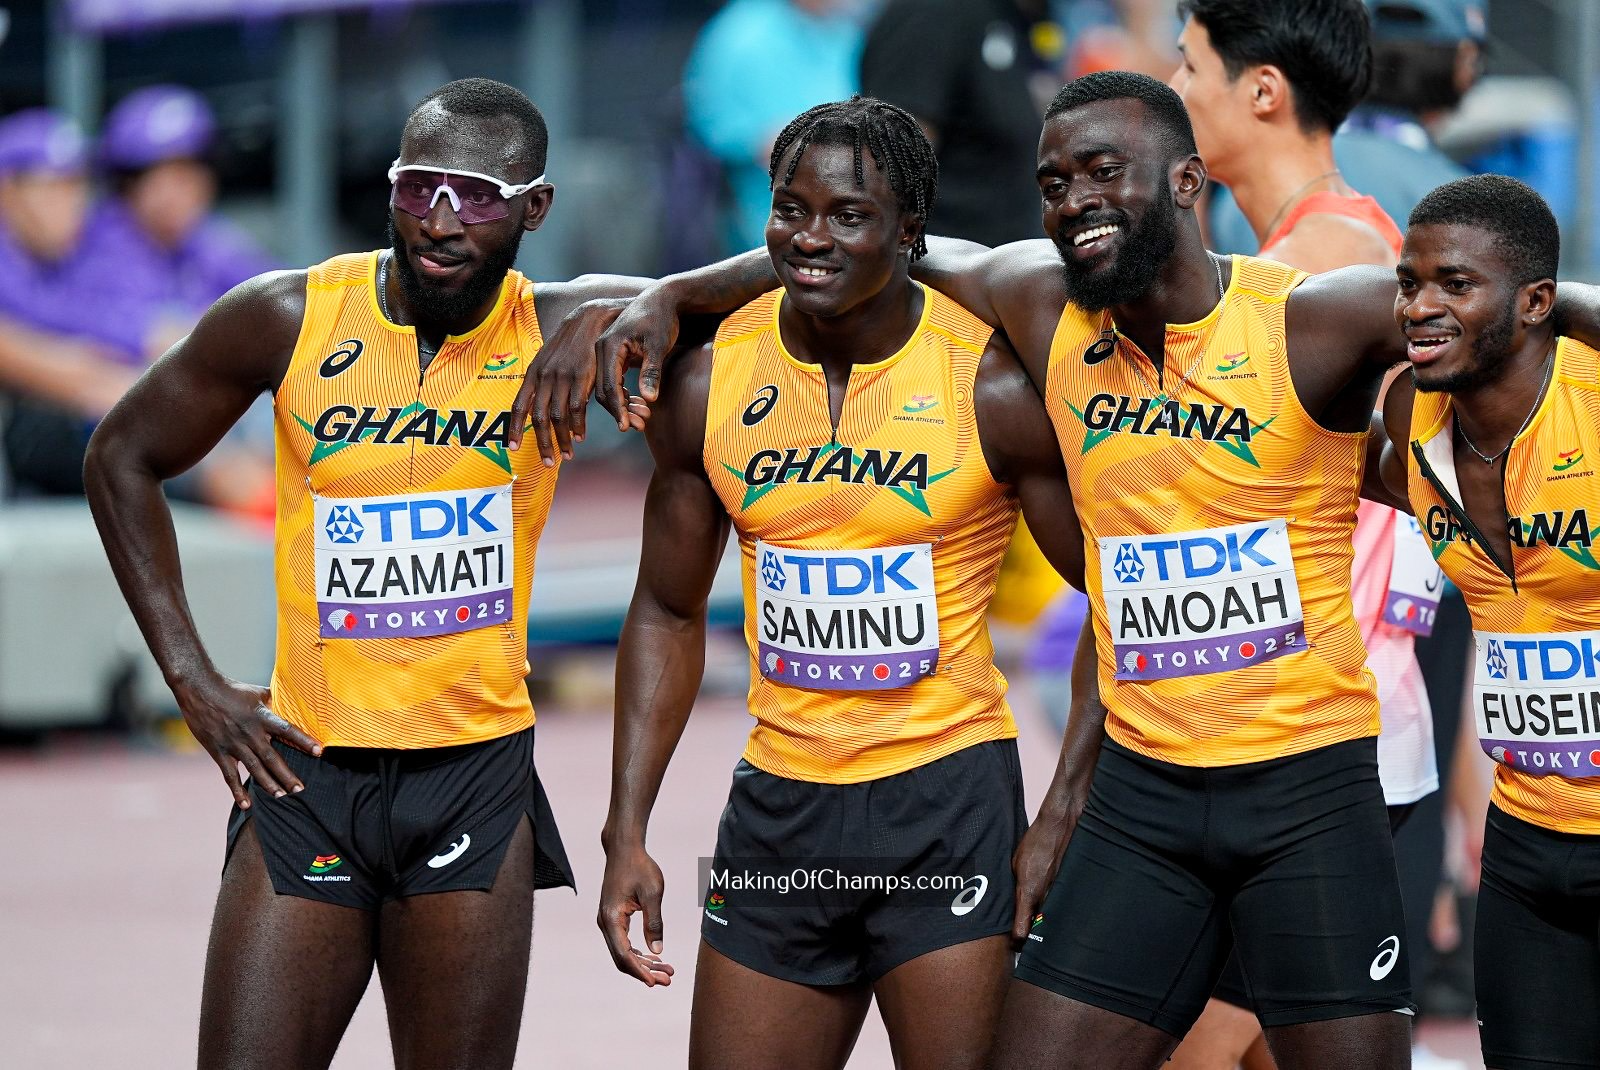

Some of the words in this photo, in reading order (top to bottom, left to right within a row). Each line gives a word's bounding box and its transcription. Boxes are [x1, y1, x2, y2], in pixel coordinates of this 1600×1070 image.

[313, 405, 513, 449] GHANA
[915, 416, 945, 425] ATHLETICS
[1083, 393, 1251, 443] GHANA
[744, 446, 928, 490] GHANA
[1546, 474, 1566, 482] GHANA
[1567, 470, 1594, 479] ATHLETICS
[362, 493, 499, 542] TDK
[326, 544, 504, 598] AZAMATI
[784, 551, 919, 596] TDK
[1142, 528, 1277, 580] TDK
[763, 600, 925, 649] SAMINU
[1120, 578, 1289, 639] AMOAH
